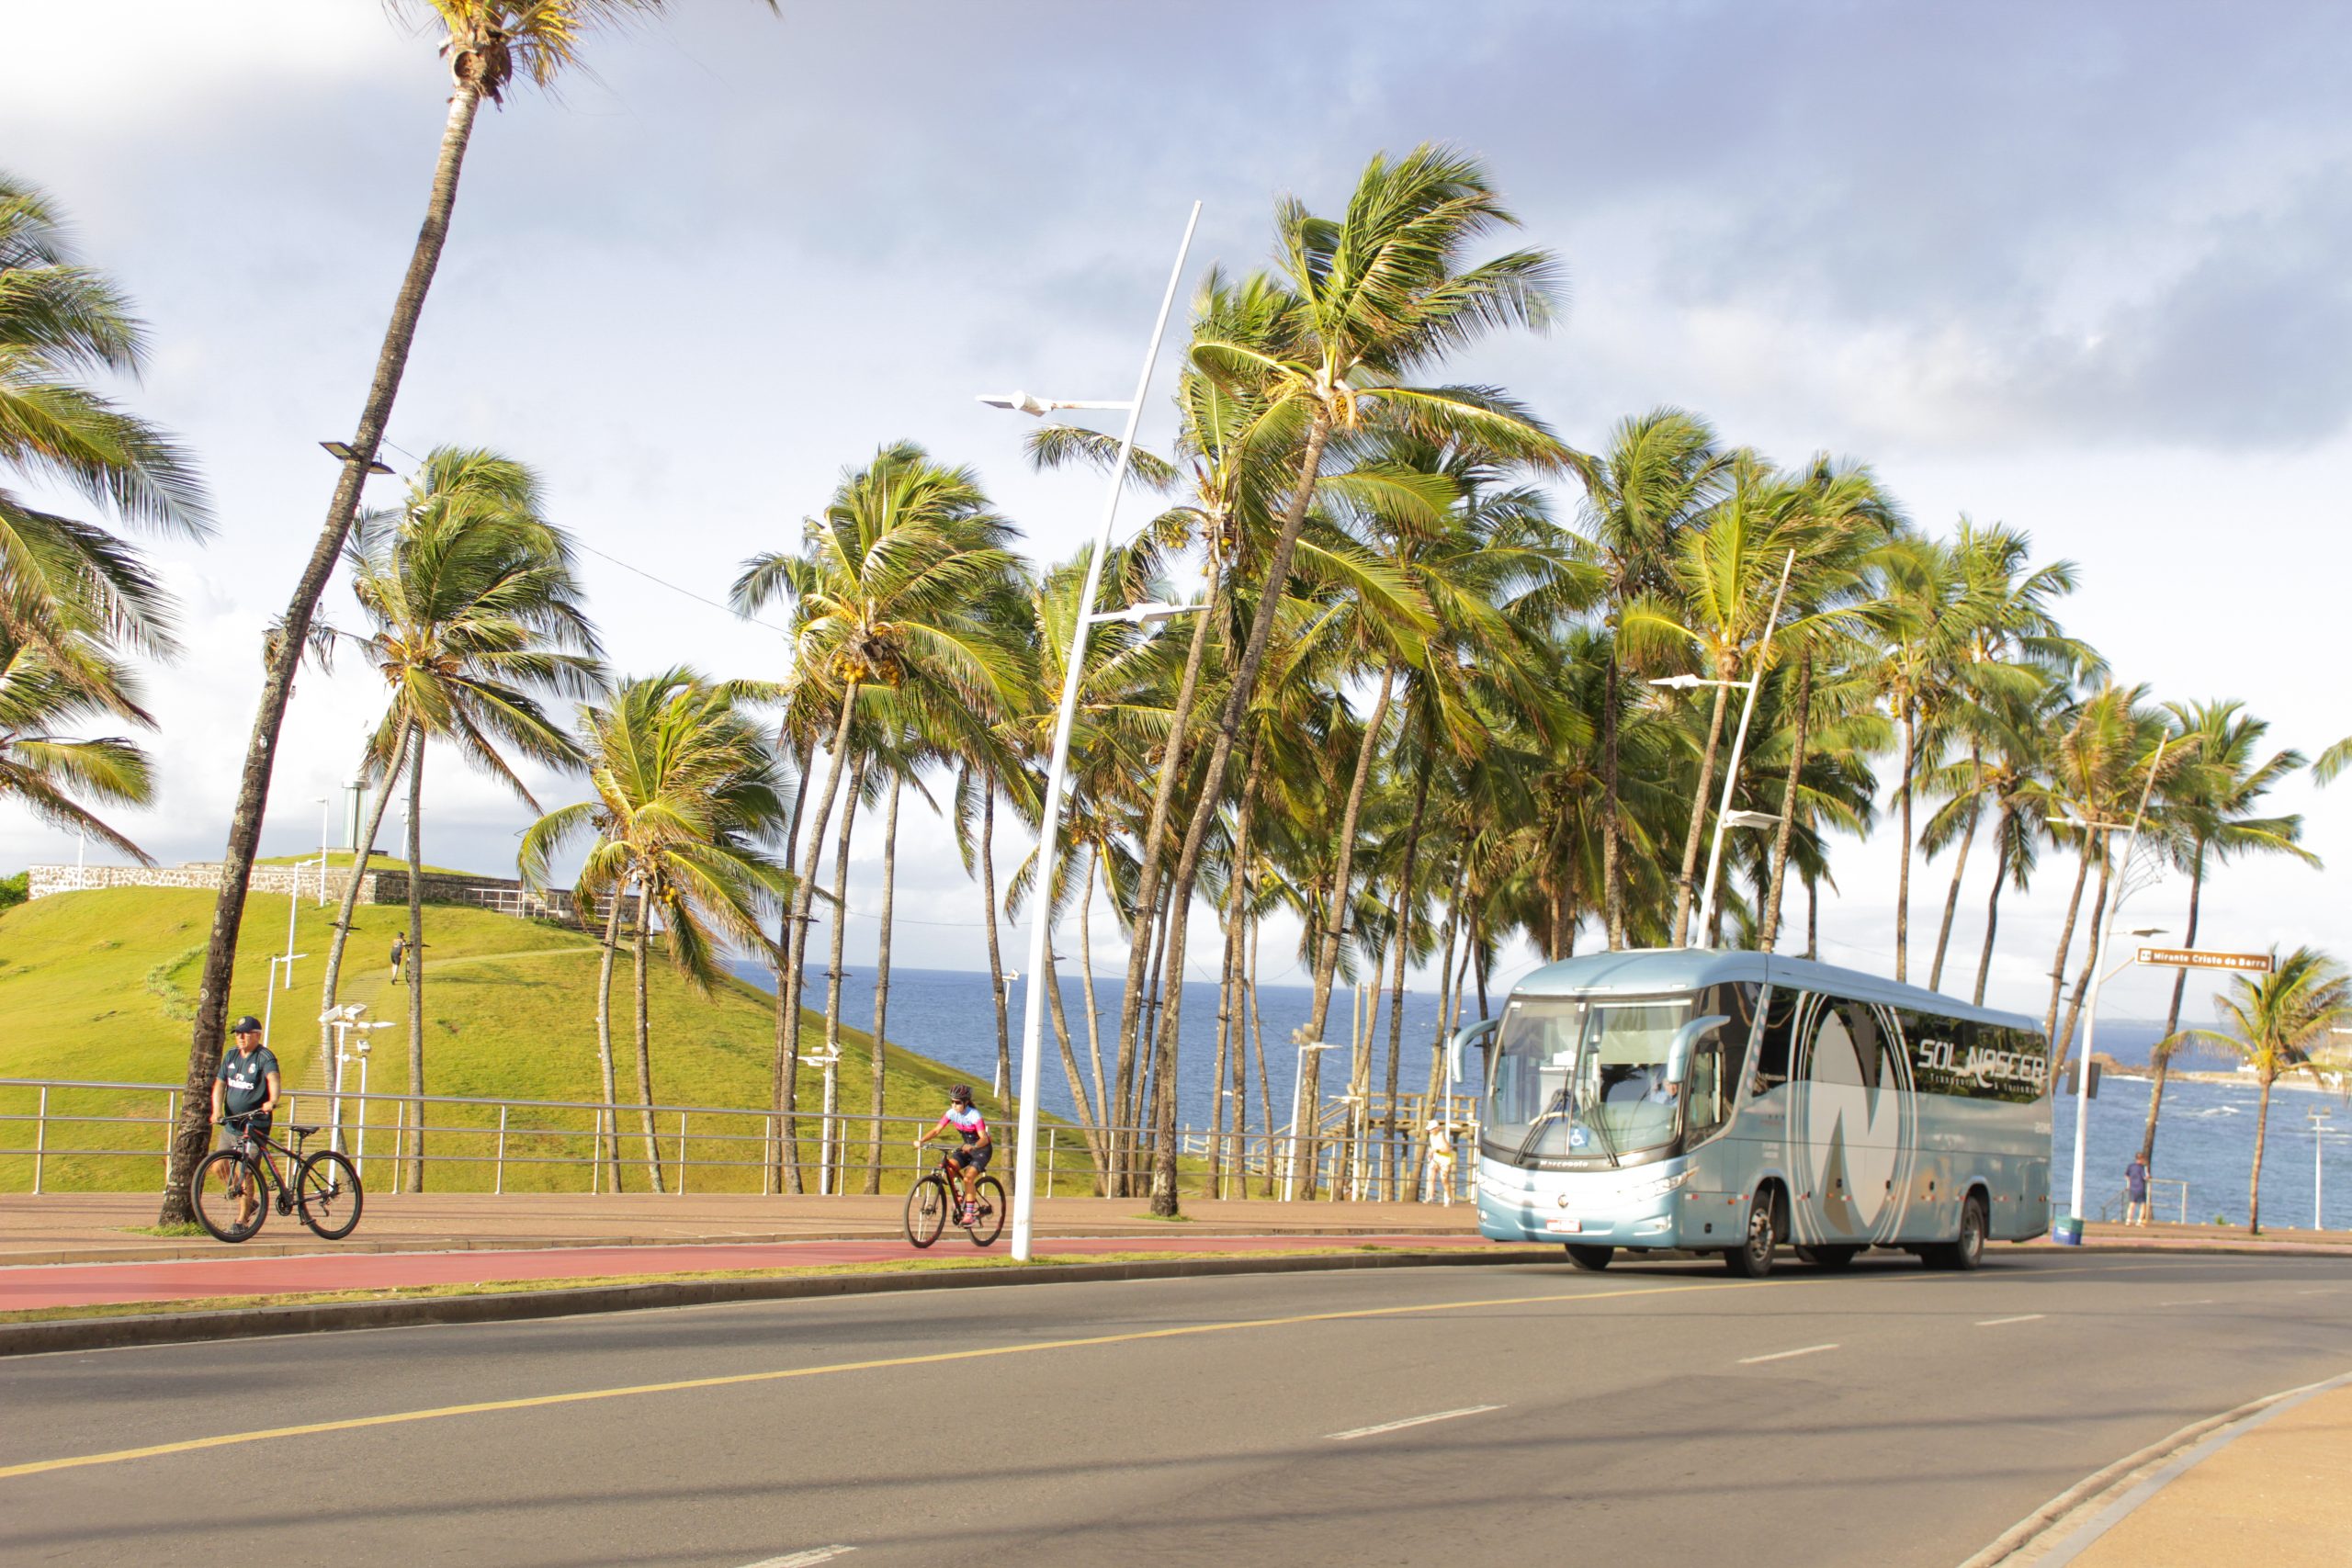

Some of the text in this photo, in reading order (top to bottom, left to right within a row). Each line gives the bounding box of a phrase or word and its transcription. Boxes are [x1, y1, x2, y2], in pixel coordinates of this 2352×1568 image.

[2153, 952, 2188, 963] Mirante
[2192, 954, 2222, 964] Cristo
[2239, 958, 2267, 968] Barra
[1917, 1039, 1962, 1074] SOL
[1540, 1160, 1589, 1168] Marcopolo
